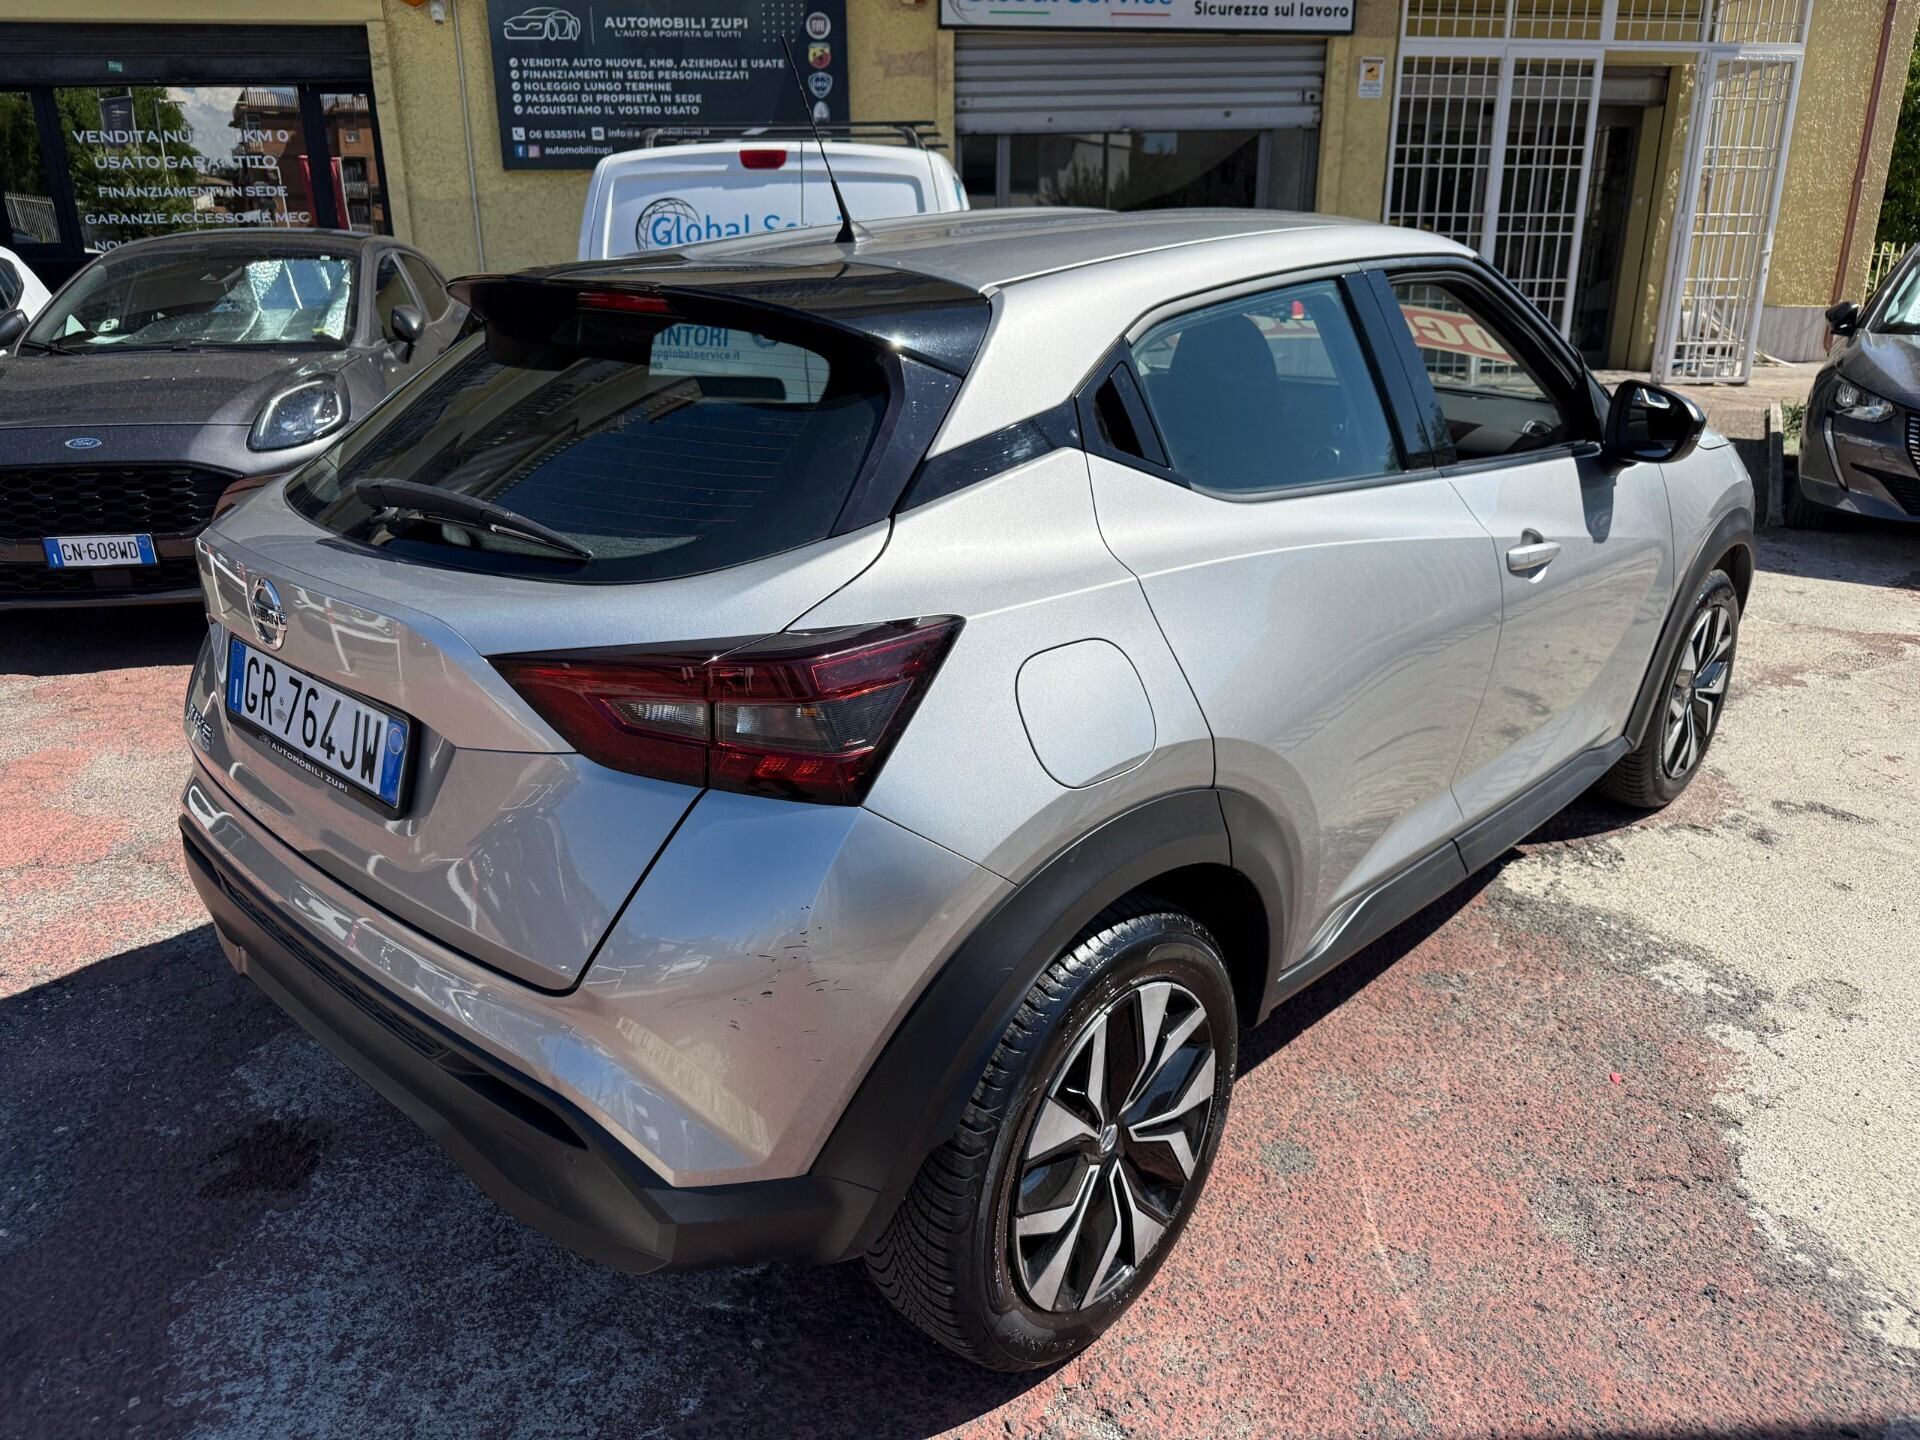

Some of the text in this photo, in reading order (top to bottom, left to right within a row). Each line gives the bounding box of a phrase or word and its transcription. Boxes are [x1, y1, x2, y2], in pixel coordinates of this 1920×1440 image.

[1194, 0, 1349, 18] Sicurezza sul lavoro
[604, 16, 748, 29] AUTOMOBILI ZUPI
[659, 30, 700, 38] PORTATA
[704, 30, 713, 38] DI
[716, 30, 742, 38] TUTTI
[521, 57, 569, 67] VENDITA
[572, 58, 602, 67] AUTO
[605, 58, 647, 69] NUOVE,
[680, 59, 737, 68] AZIENDALI
[741, 59, 748, 68] E
[751, 59, 785, 69] USATE
[523, 70, 749, 80] FINANZIAMENTI IN SEDE PERSONALIZZATI
[524, 82, 672, 91] NOLEGGIO LUNGO TERMINE
[525, 91, 702, 103] PASSAGGI DI PROPRIETÀ IN SEDE
[526, 105, 700, 115] ACQUISTIAMO IL VOSTRO USATO
[72, 130, 159, 143] VENDITA
[243, 129, 273, 142] KM
[528, 130, 542, 139] 06
[544, 130, 586, 139] 85385114
[544, 145, 613, 156] automobilizupi
[94, 155, 160, 169] USATO
[98, 185, 289, 198] FINANZIAMENTI IN SEDE
[84, 213, 167, 225] GARANZIE
[275, 211, 311, 223] MEC
[652, 213, 750, 246] Global
[653, 325, 729, 348] INTORI
[271, 742, 348, 793] AUTOMOBILI ZUPI
